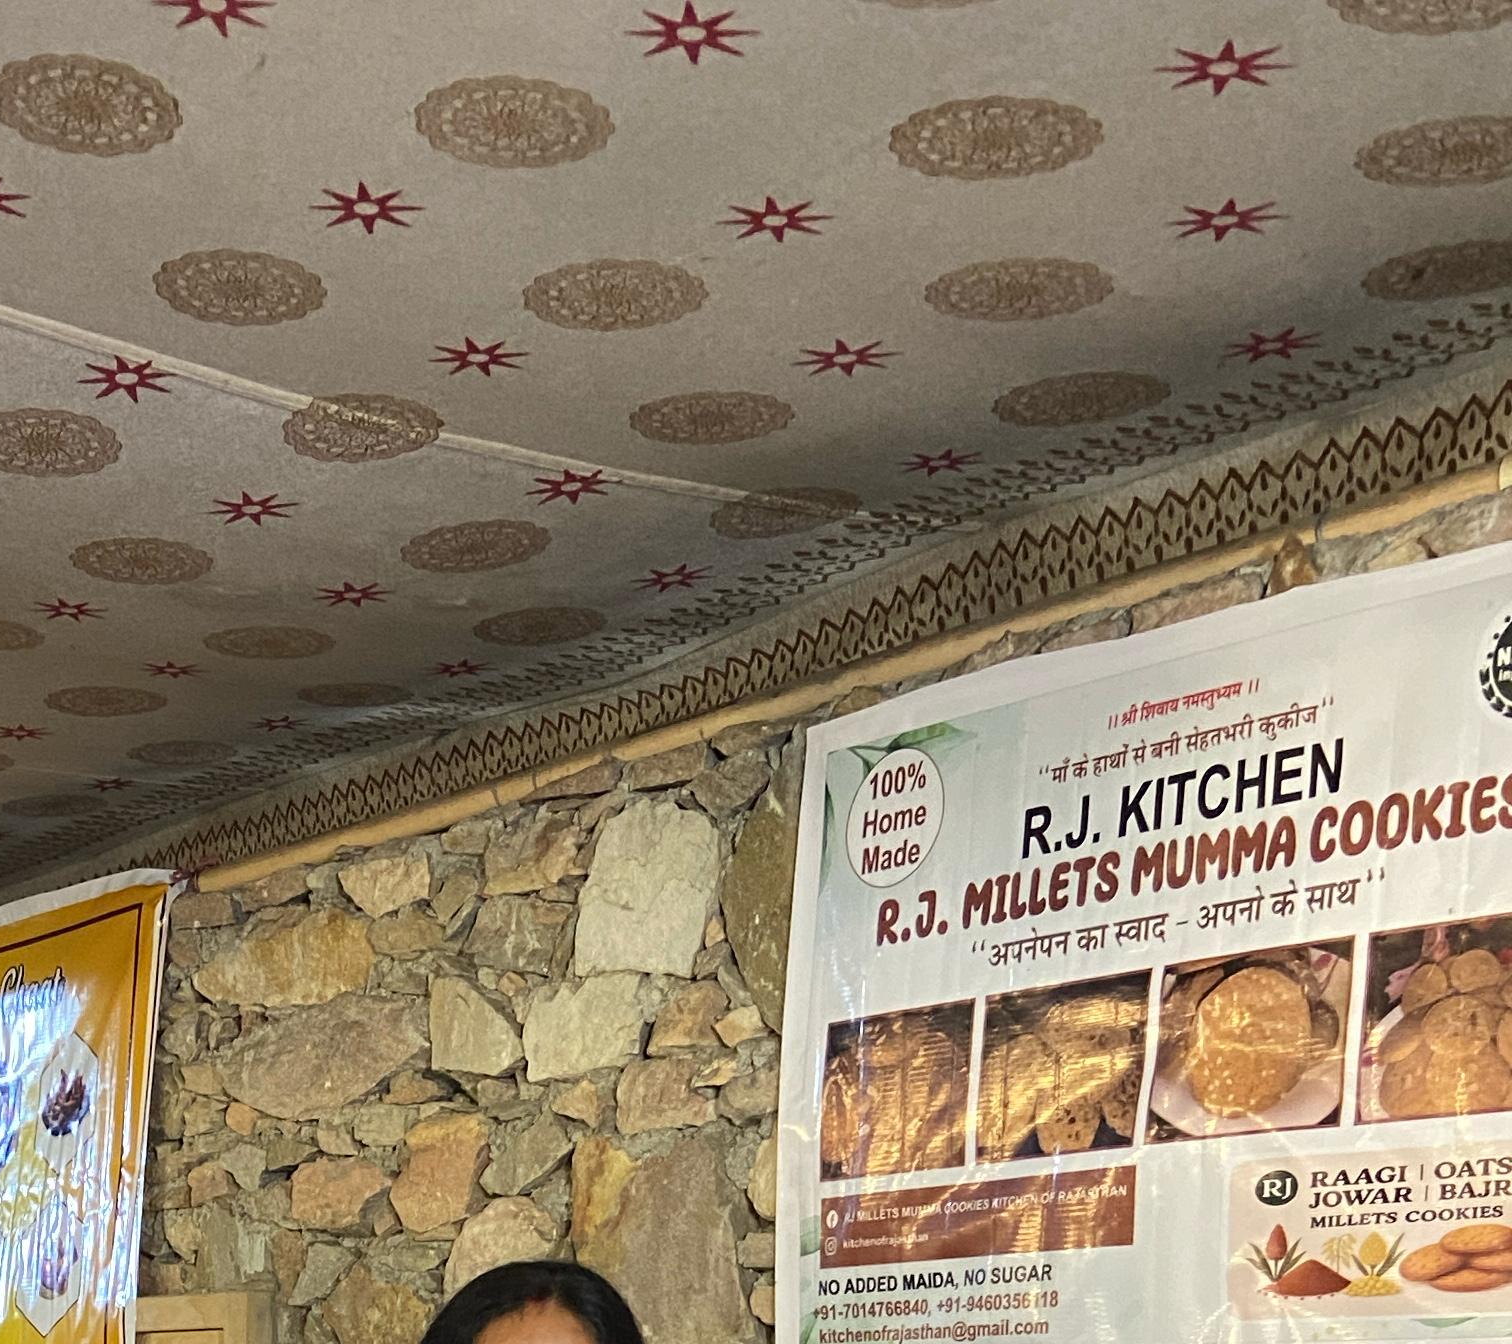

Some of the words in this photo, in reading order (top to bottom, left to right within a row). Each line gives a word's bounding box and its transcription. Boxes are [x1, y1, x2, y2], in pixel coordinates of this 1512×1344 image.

[1140, 698, 1180, 722] शिवाय
[1073, 752, 1090, 779] के
[1093, 744, 1129, 777] हाथों
[1132, 740, 1146, 766] से
[1150, 732, 1180, 759] बनी
[1185, 716, 1253, 753] सेहतभरी
[869, 760, 927, 801] 100%
[1021, 794, 1101, 859] R.J.
[1118, 737, 1345, 838] KITCHEN
[862, 804, 927, 839] Home
[861, 839, 921, 875] Made
[876, 890, 949, 947] R.J.
[962, 850, 1121, 930] MILLETS
[1131, 815, 1297, 897] MUMMA
[1077, 923, 1107, 953] का
[1114, 913, 1168, 946] स्वाद
[1271, 880, 1299, 917] के
[1310, 1165, 1408, 1188] RAAGI
[1434, 1156, 1512, 1179] OATS
[1261, 1177, 1292, 1200] RJ
[1309, 1187, 1412, 1209] JOWAR
[1439, 1180, 1512, 1201] BAJR
[856, 1206, 899, 1221] MILLETS
[944, 1198, 990, 1214] COOKIES
[992, 1191, 1038, 1209] KITCHEN
[1041, 1190, 1055, 1204] OF
[1310, 1211, 1398, 1229] MILLETS
[1405, 1205, 1504, 1224] COOKIES
[818, 1280, 840, 1296] NO
[844, 1275, 898, 1294] ADDED
[902, 1271, 959, 1291] MAIDA,
[964, 1268, 986, 1286] NO
[991, 1264, 1052, 1284] SUGAR
[813, 1299, 931, 1320] +91-7014766840,
[819, 1320, 1048, 1344] kitchenofrajasthan@gmail.com
